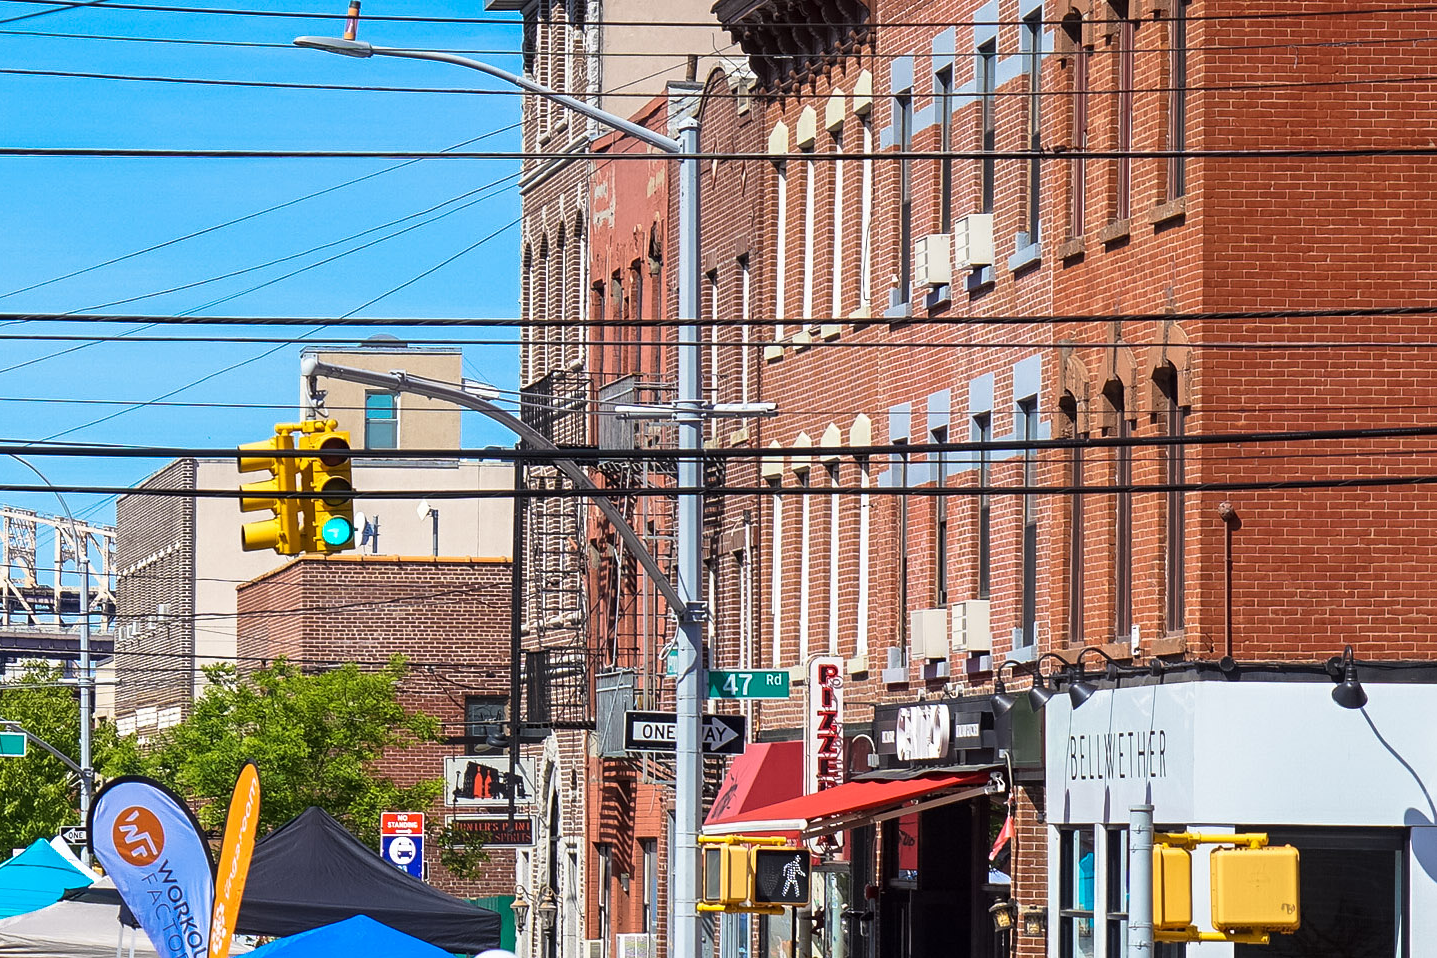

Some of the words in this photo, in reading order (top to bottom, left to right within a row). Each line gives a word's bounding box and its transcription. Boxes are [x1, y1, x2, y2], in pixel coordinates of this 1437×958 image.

[722, 673, 753, 696] 47
[766, 673, 782, 686] Rd
[643, 724, 676, 740] ONE
[702, 725, 727, 741] AY
[817, 663, 839, 847] PIZZERA
[1070, 730, 1166, 780] BELLWETHER
[68, 831, 83, 839] ONE
[502, 822, 531, 831] PINT
